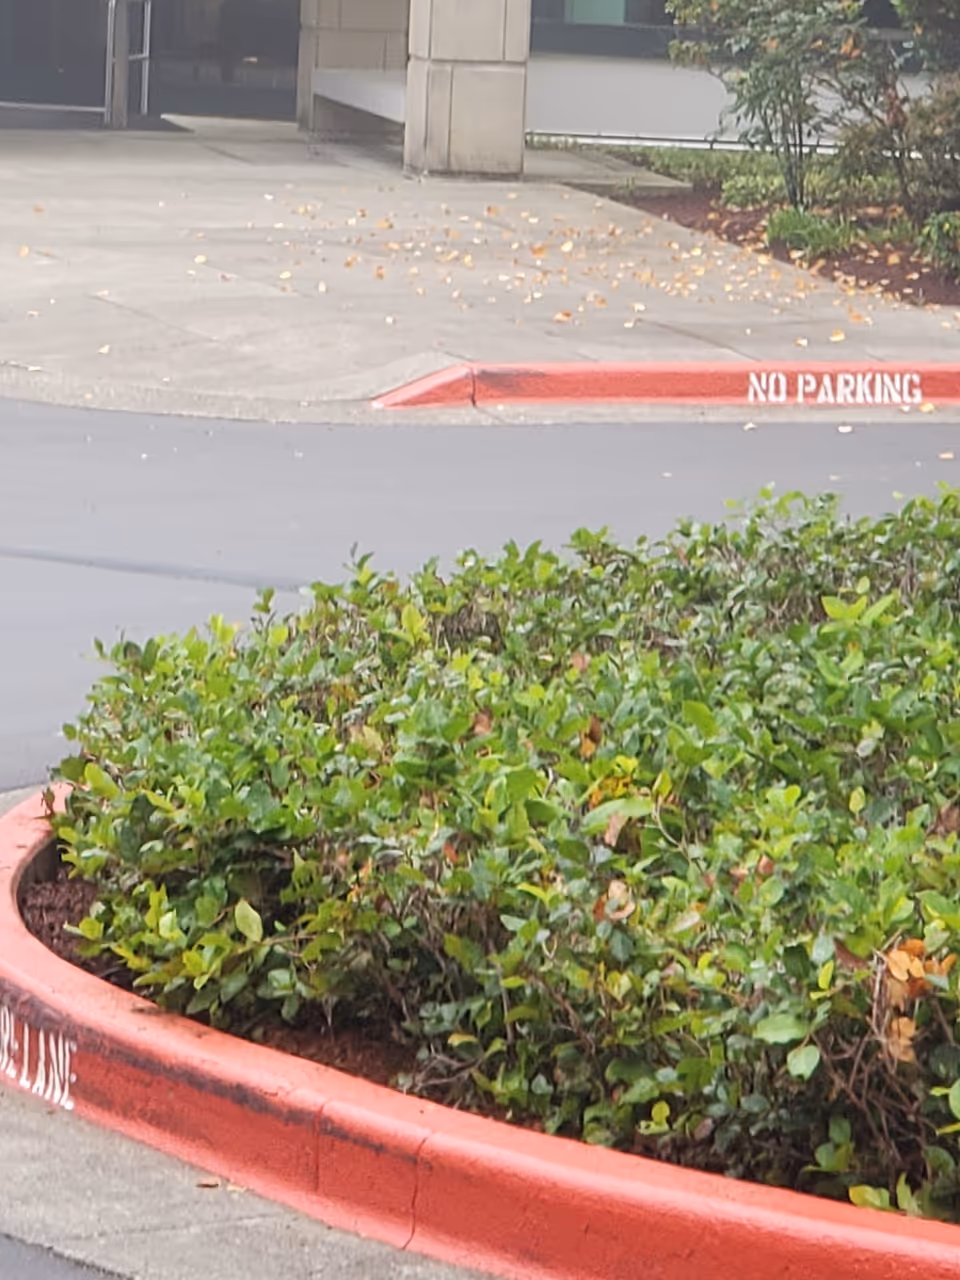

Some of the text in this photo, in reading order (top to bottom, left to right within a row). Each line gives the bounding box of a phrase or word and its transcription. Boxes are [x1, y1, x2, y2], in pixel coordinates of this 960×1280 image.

[747, 371, 922, 404] NO PARKING
[19, 1022, 77, 1111] LANE
